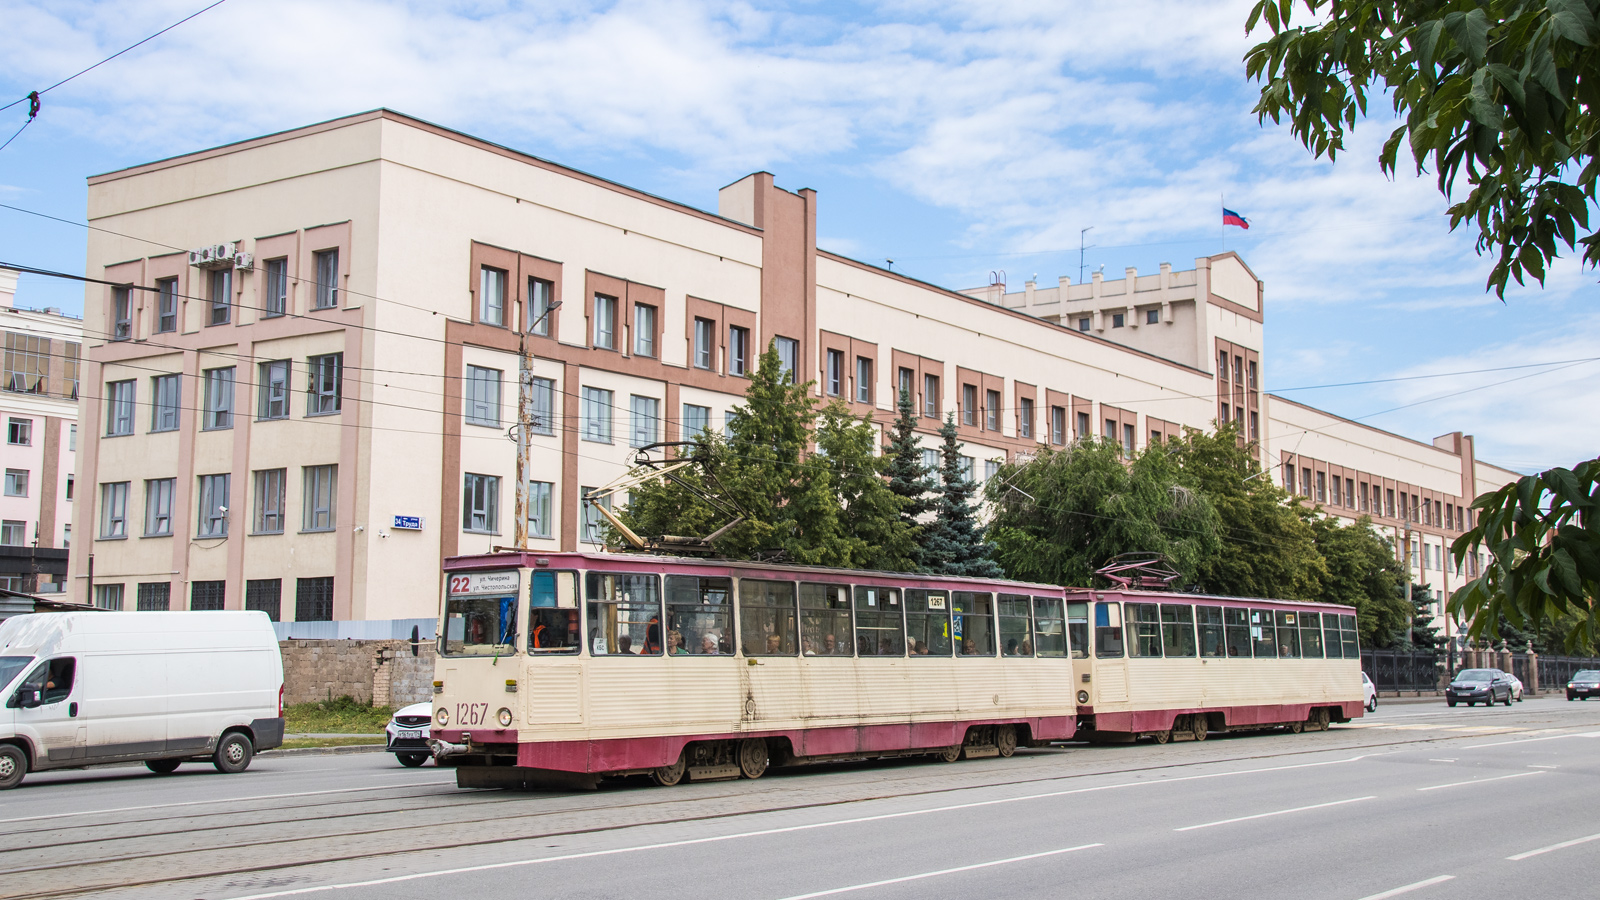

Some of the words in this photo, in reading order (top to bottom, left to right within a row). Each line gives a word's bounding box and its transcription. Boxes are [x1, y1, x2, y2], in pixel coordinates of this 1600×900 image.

[402, 520, 418, 528] Труда
[452, 577, 470, 593] 22
[930, 597, 943, 607] 1267
[456, 703, 489, 726] 1267
